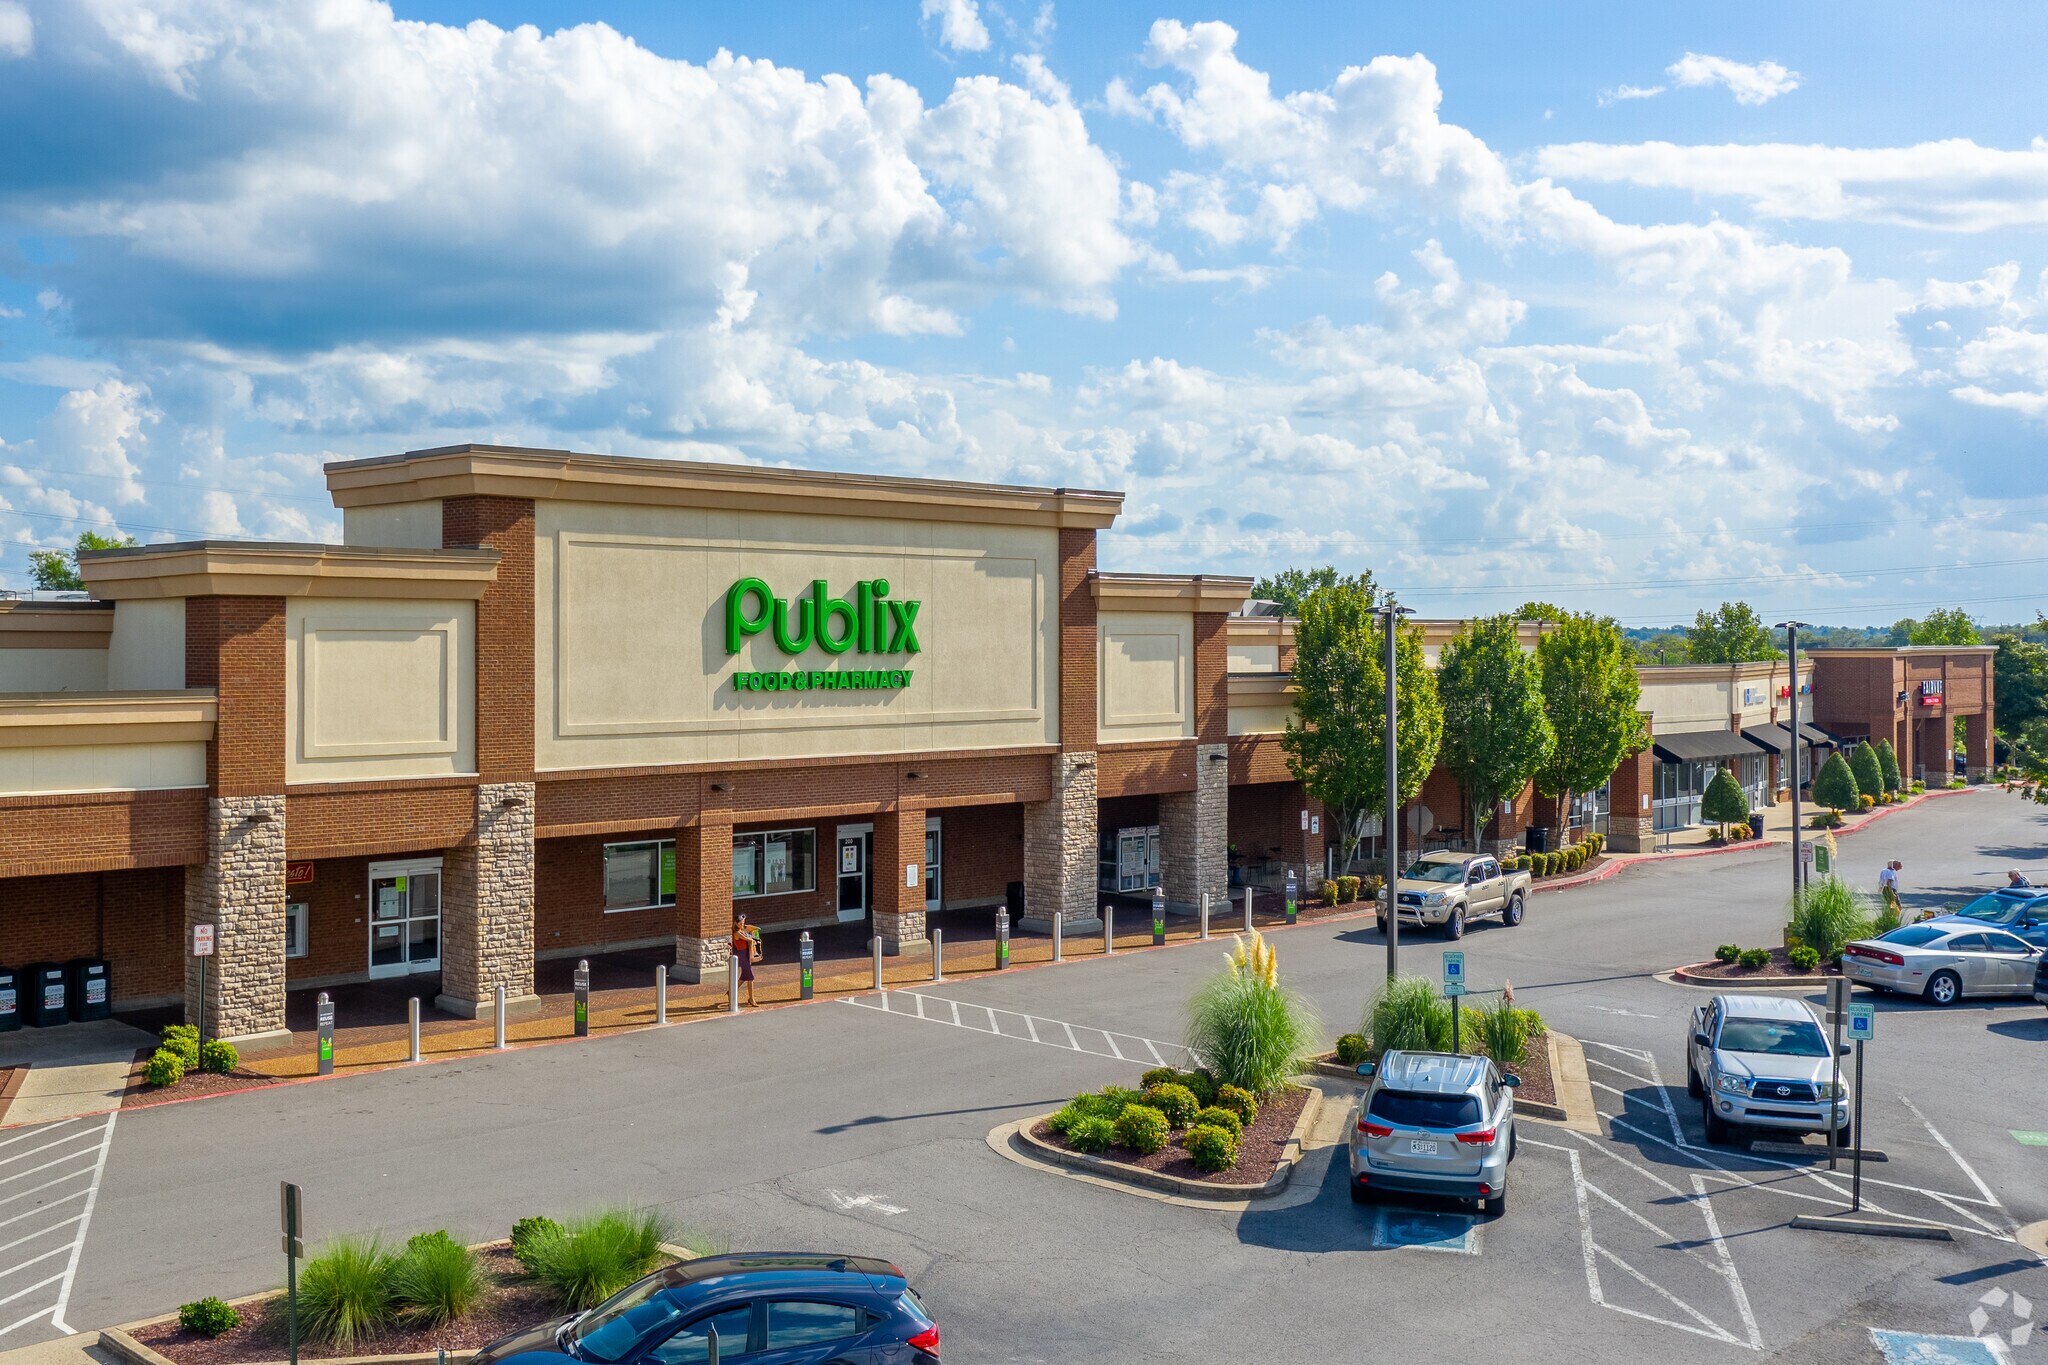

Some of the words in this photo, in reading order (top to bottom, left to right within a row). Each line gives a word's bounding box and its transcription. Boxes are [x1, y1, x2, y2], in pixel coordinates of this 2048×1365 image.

[726, 577, 922, 655] Publix
[733, 671, 793, 691] FOOD
[808, 670, 914, 691] PHARMACY
[200, 927, 208, 935] NO
